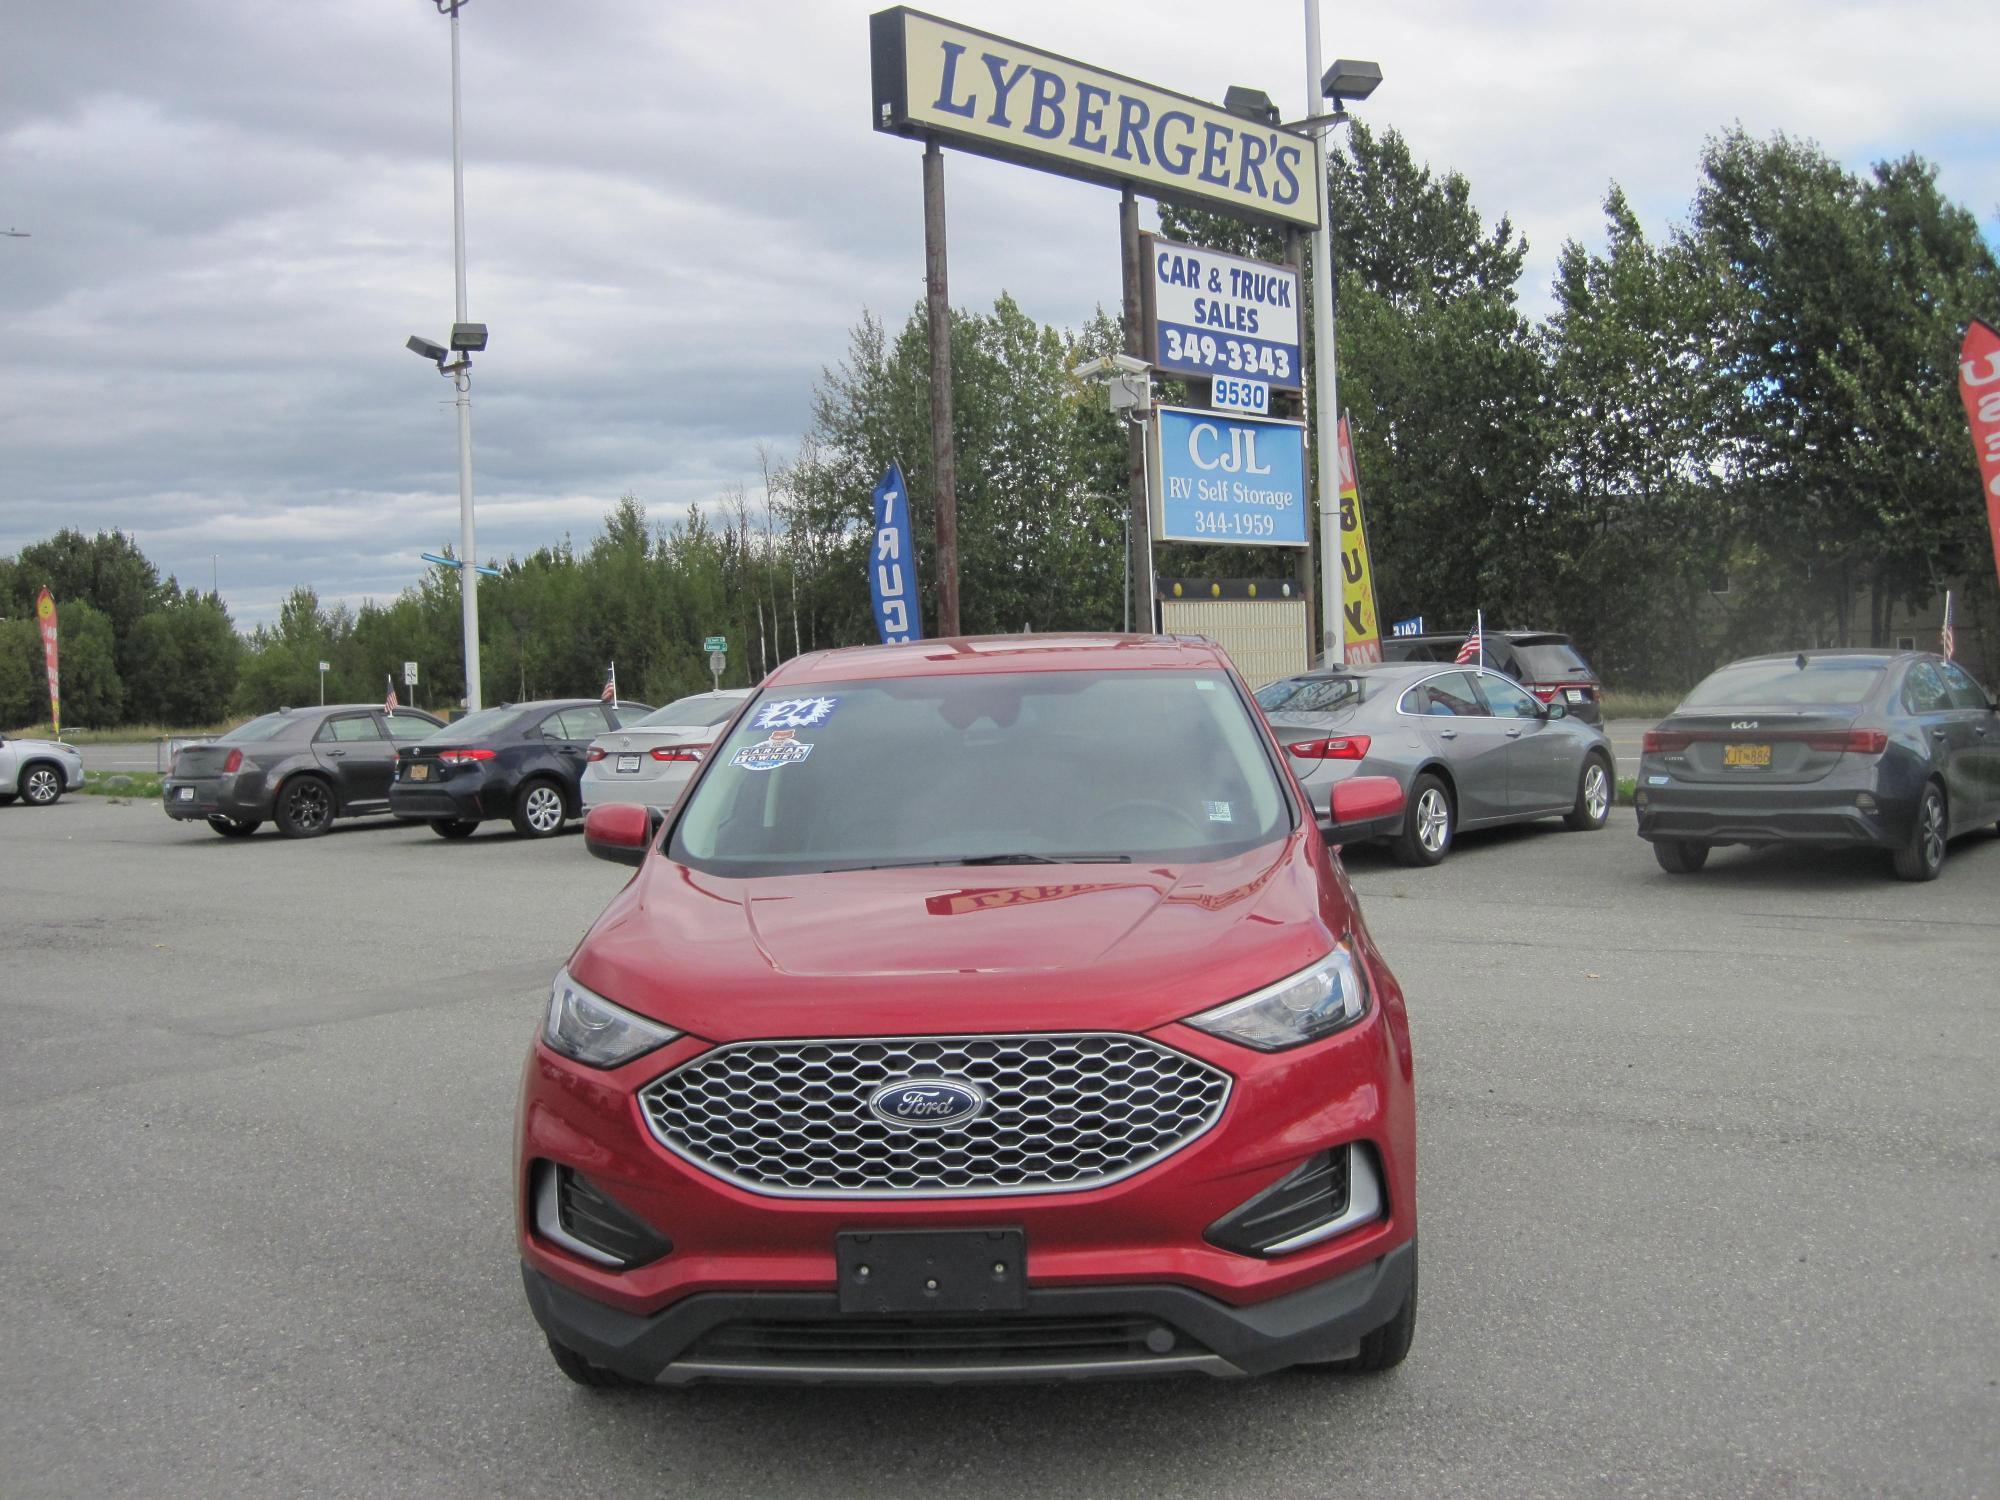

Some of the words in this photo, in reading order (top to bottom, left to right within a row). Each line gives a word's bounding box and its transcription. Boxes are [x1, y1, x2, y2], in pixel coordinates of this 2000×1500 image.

[932, 40, 1300, 206] LYBERGER'S
[1157, 252, 1200, 289] CAR
[1207, 267, 1222, 294] &
[1230, 268, 1291, 308] TRUCK
[1194, 297, 1259, 334] SALES
[1165, 329, 1290, 378] 349-3343
[1215, 379, 1265, 409] 9530
[1188, 423, 1271, 475] CJL
[1169, 476, 1192, 499] RV
[1198, 478, 1228, 502] Self
[1233, 481, 1293, 510] Storage
[1194, 511, 1275, 536] 344-1959
[897, 1090, 954, 1115] Ford
